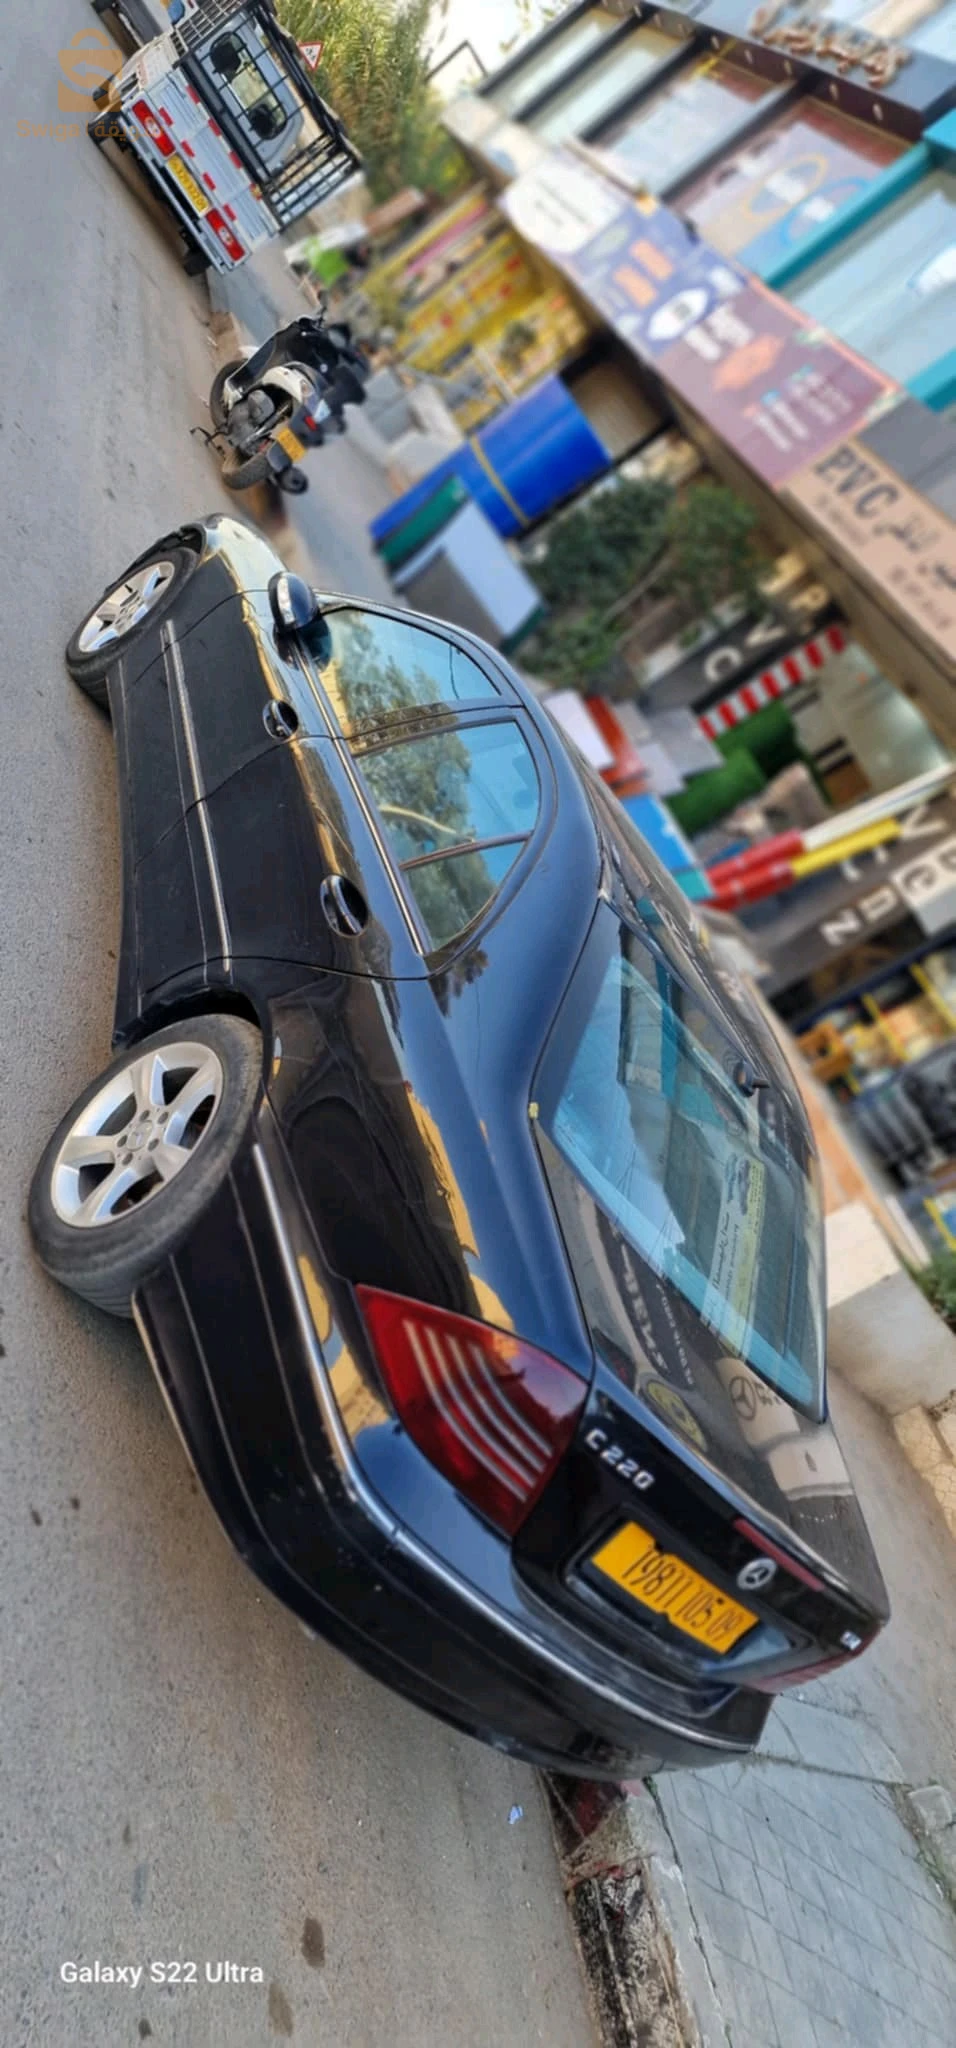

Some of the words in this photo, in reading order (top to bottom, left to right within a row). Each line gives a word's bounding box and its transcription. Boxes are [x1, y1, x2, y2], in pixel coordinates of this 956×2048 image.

[814, 445, 899, 518] PVC
[585, 1428, 608, 1450] C
[601, 1444, 655, 1490] 220
[705, 1607, 744, 1643] 09
